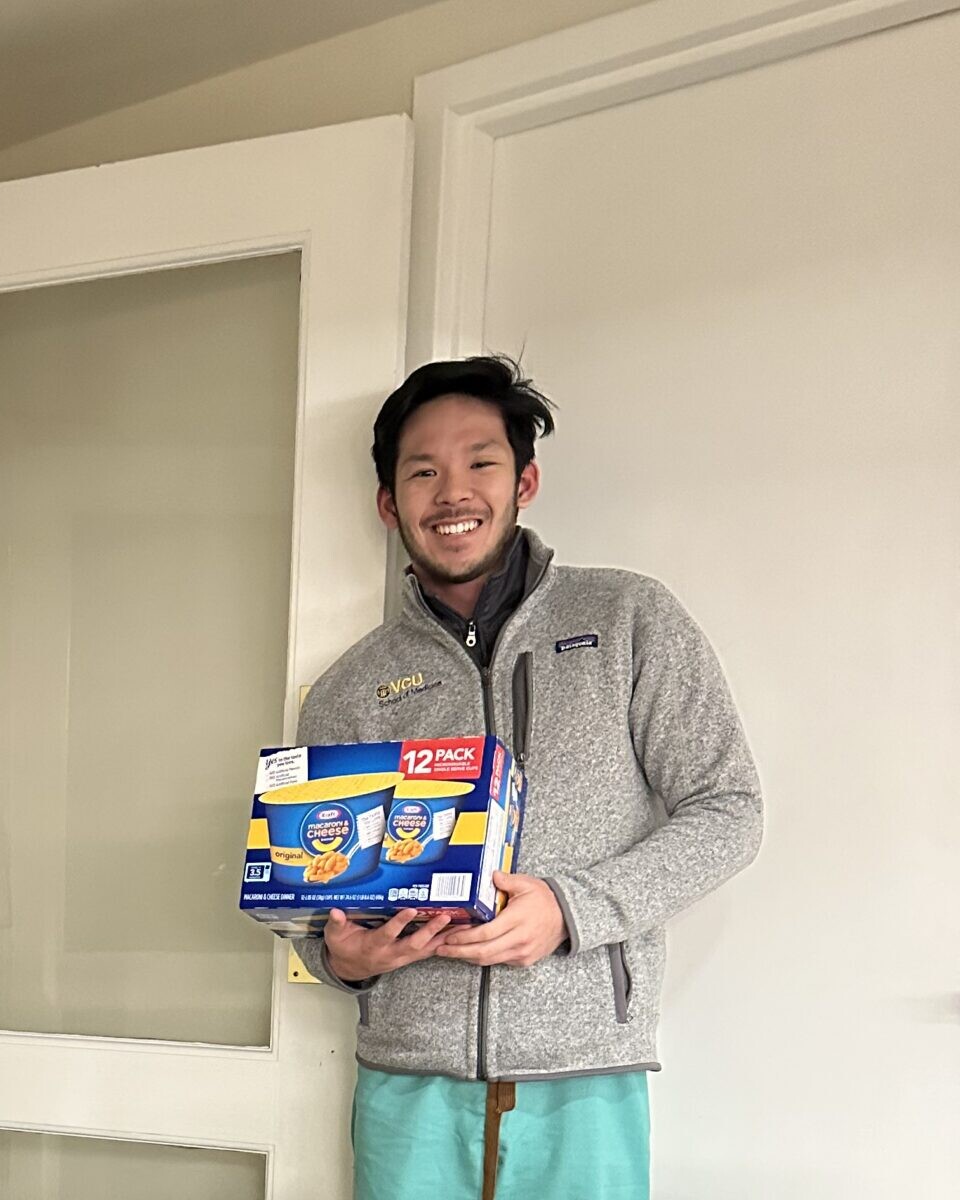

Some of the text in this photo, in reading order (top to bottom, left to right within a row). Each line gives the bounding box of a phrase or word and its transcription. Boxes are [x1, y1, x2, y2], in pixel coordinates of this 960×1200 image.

[390, 673, 424, 694] VCU
[265, 758, 278, 770] Yes
[403, 748, 476, 774] 12 PACK
[308, 820, 342, 830] macaroni
[275, 851, 303, 860] original
[249, 868, 261, 877] 3.5
